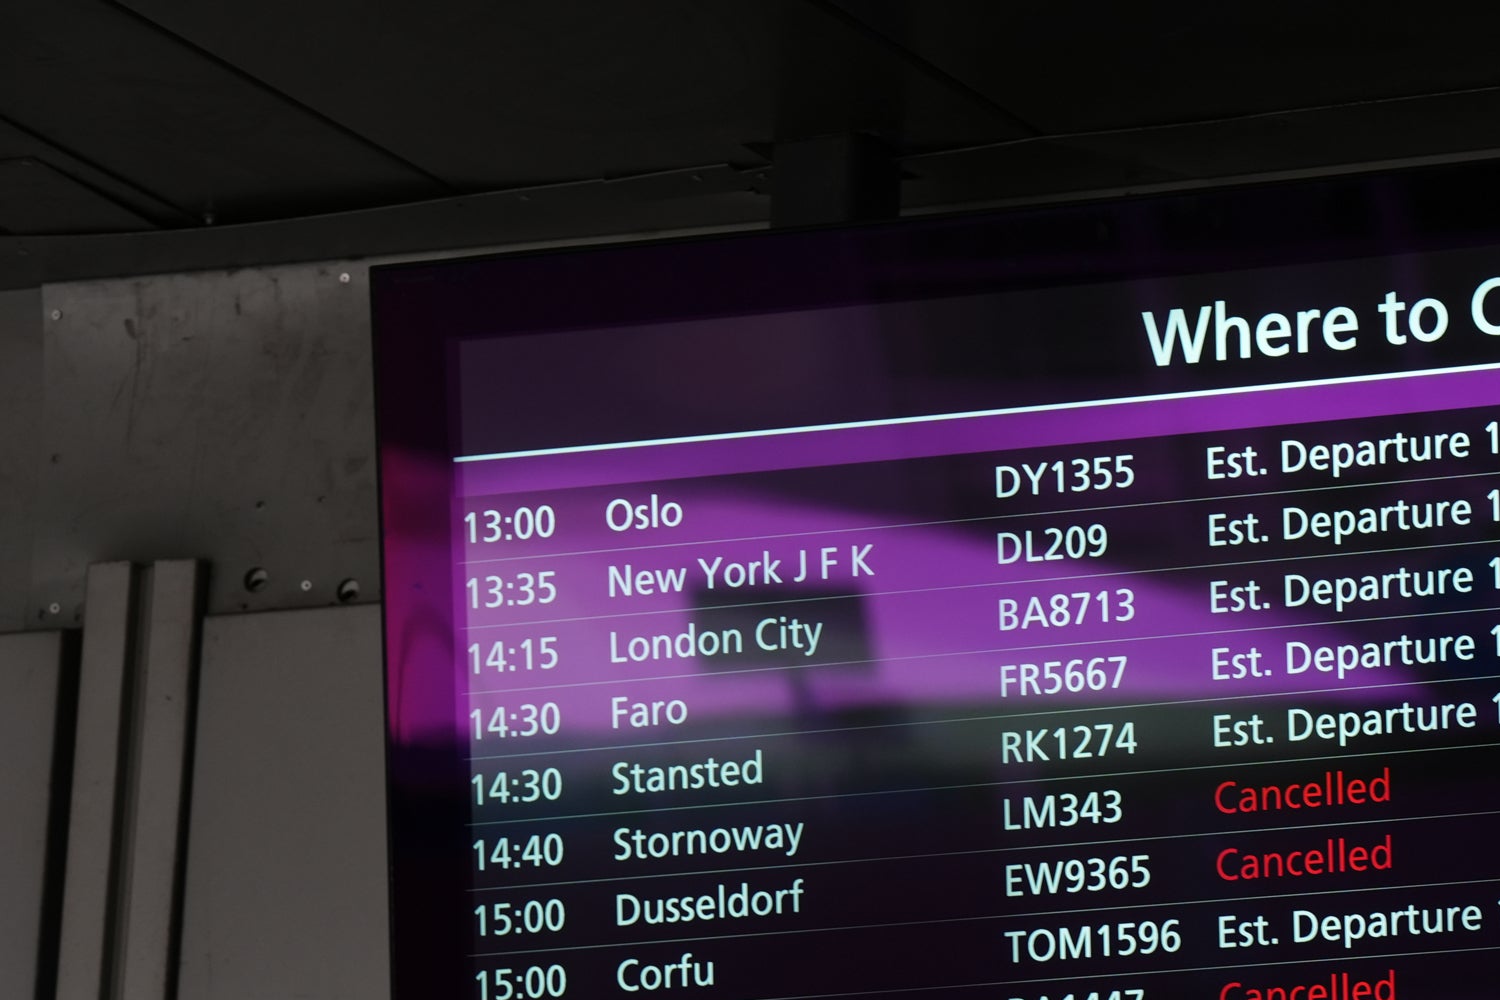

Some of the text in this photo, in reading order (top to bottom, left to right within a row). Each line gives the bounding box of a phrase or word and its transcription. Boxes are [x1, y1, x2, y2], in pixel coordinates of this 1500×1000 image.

[1141, 300, 1360, 367] Where
[1376, 290, 1450, 346] to
[464, 504, 556, 543] 13:00
[605, 493, 683, 532] Oslo
[994, 453, 1135, 499] DY1355
[1206, 445, 1268, 480] Est.
[1280, 431, 1471, 479] Departure
[466, 570, 558, 609] 13:35
[608, 564, 686, 597] New
[697, 550, 783, 590] York
[793, 550, 807, 584] J
[821, 547, 837, 580] F
[851, 544, 875, 577] K
[996, 523, 1108, 564] DL209
[1207, 512, 1269, 547] Est.
[1282, 499, 1473, 546] Departure
[468, 636, 560, 675] 14:15
[611, 623, 743, 663] London
[755, 615, 823, 657] City
[999, 587, 1135, 631] BA8713
[1209, 579, 1271, 614] Est.
[1283, 566, 1474, 613] Departure
[469, 701, 561, 740] 14:30
[612, 697, 687, 729] Faro
[1001, 656, 1127, 697] FR5667
[1212, 647, 1272, 680] Est.
[1286, 634, 1476, 680] Departure
[471, 767, 563, 806] 14:30
[611, 749, 763, 796] Stansted
[1001, 721, 1138, 764] RK1274
[1212, 713, 1274, 748] Est.
[1287, 701, 1478, 748] Departure
[472, 766, 1391, 872] 14:40 Stornoway LM343 Cancelled
[474, 833, 1393, 937] 15:00 Dusseldorf EW9365 Cancelled
[616, 952, 715, 993] Corfu
[1003, 918, 1182, 964] TOM1596
[1217, 914, 1279, 949] Est.
[1292, 904, 1483, 950] Departure
